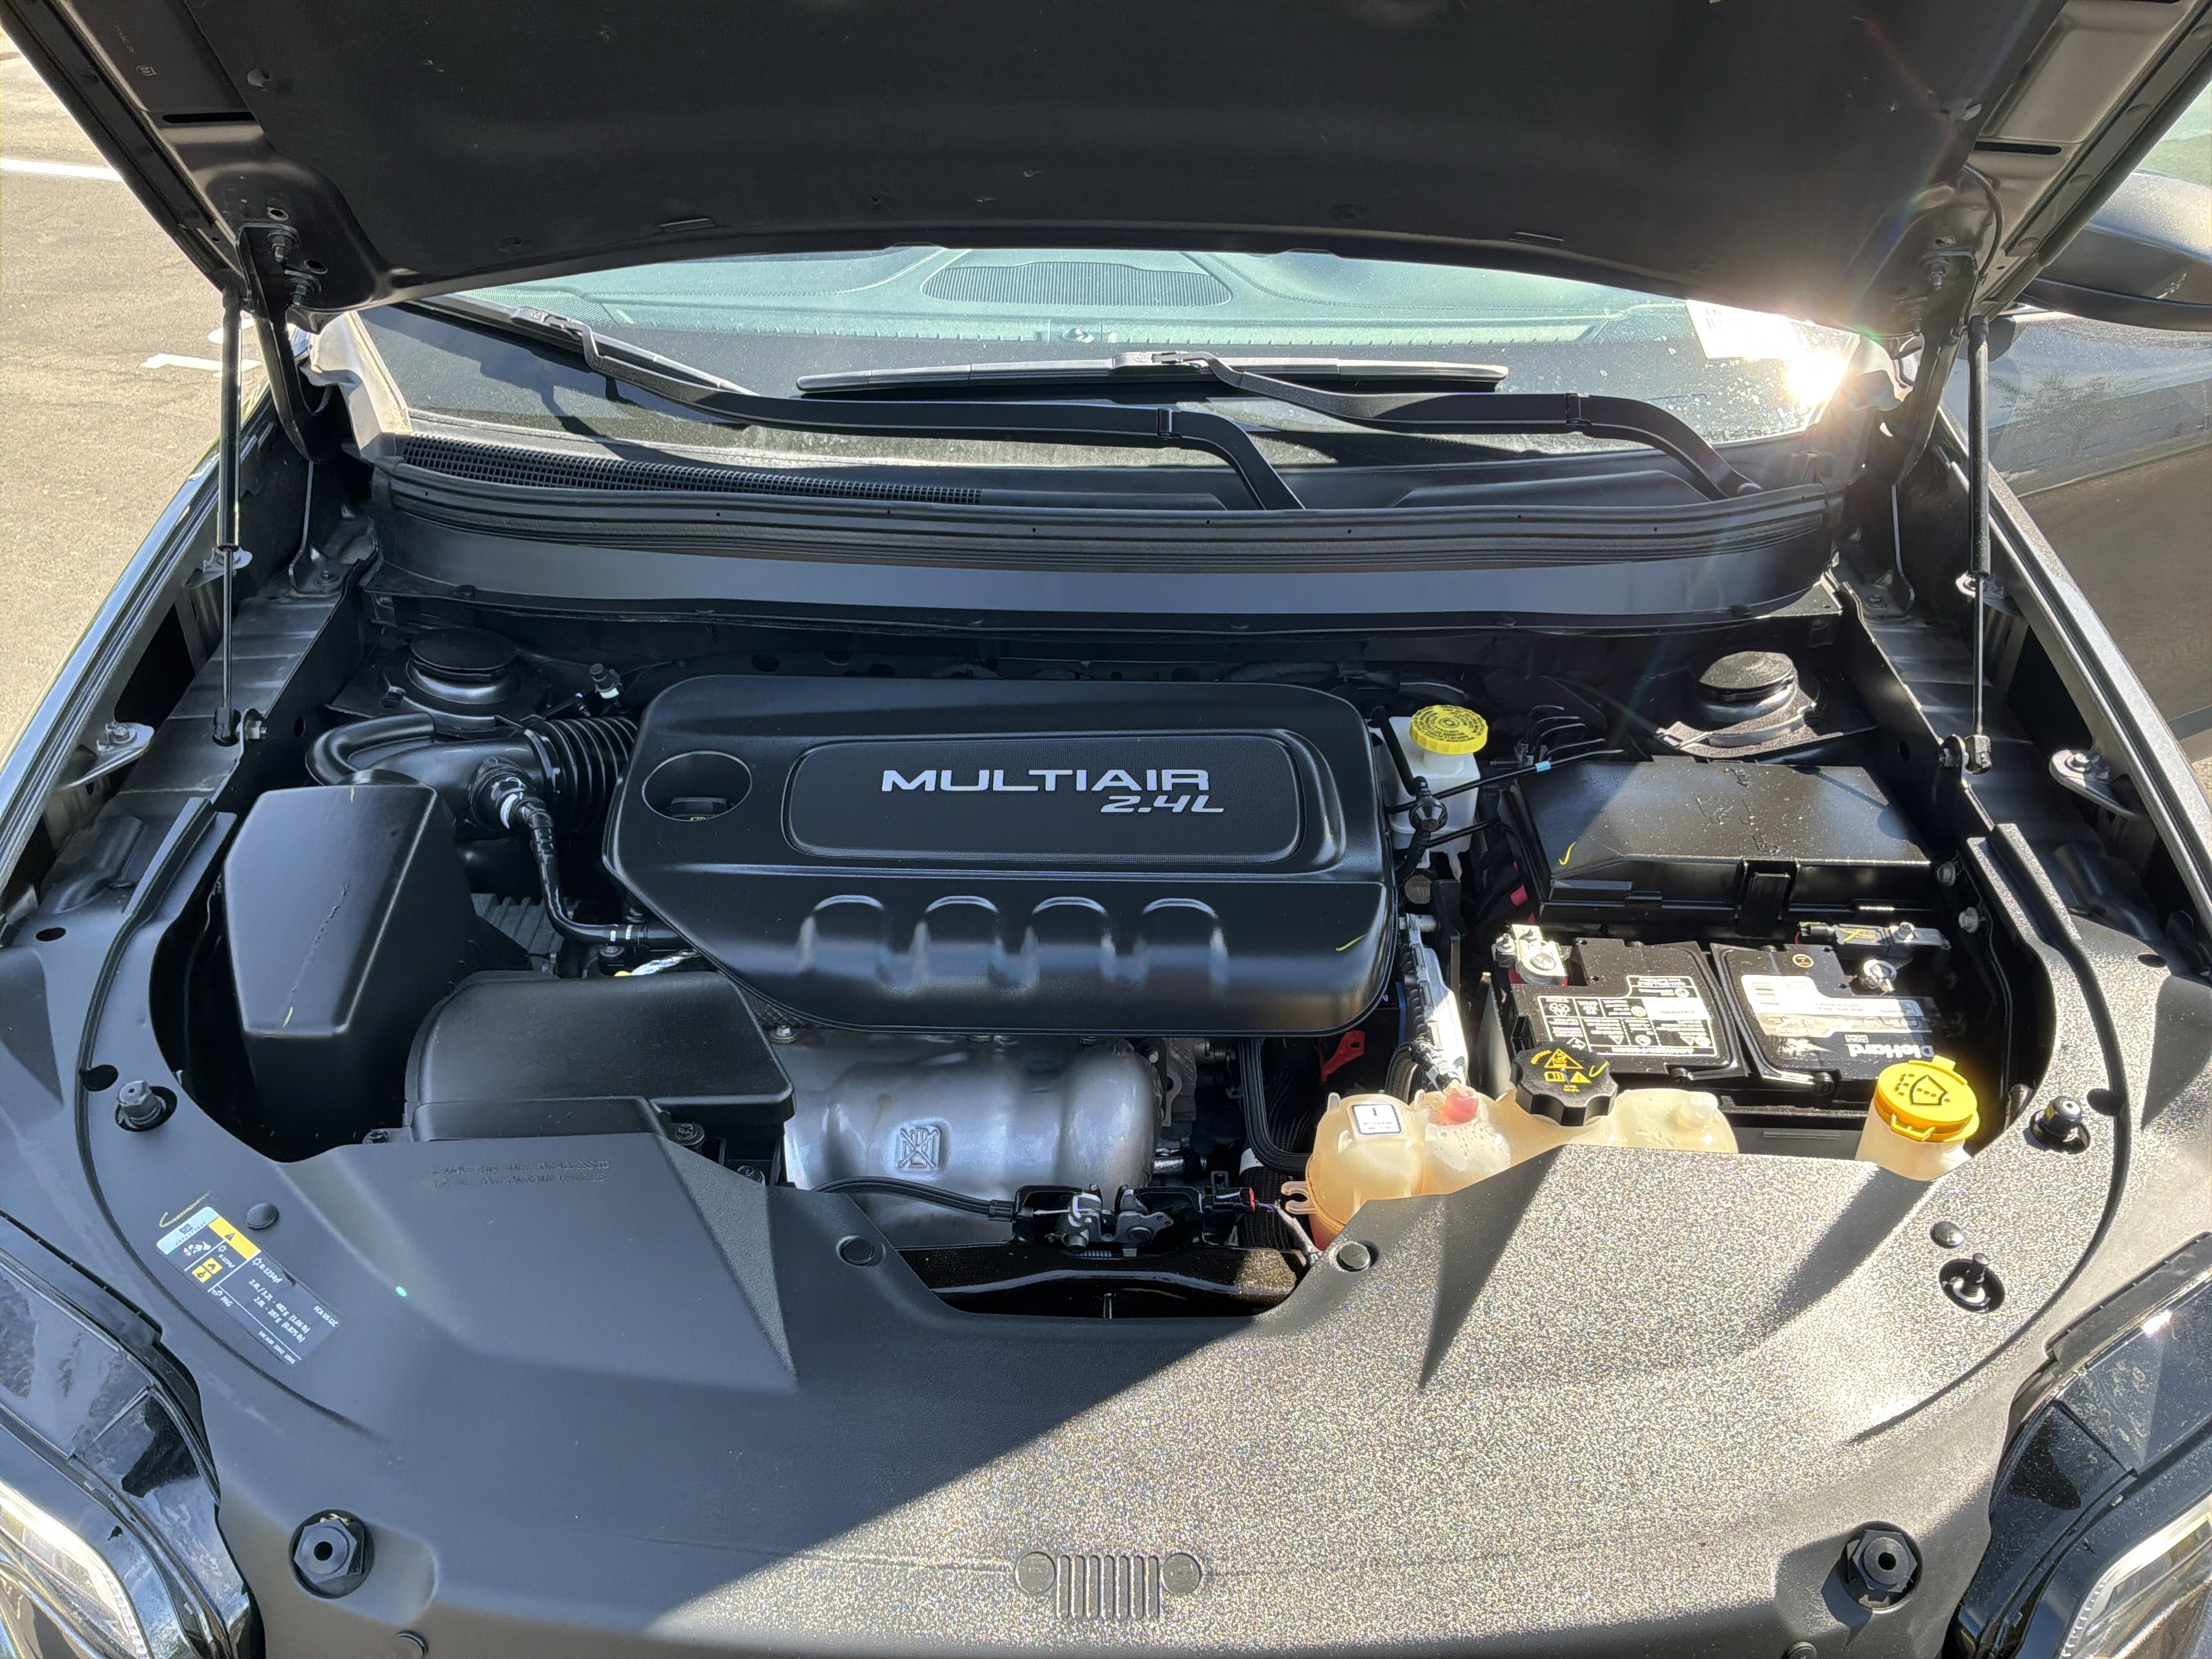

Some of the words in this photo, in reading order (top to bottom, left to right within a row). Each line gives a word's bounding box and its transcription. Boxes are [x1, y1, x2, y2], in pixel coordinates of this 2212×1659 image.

[881, 769, 1210, 792] MULTIAIR
[1100, 795, 1225, 814] 2.4L
[1848, 1044, 1934, 1058] DieHard
[221, 1296, 233, 1307] PAG
[313, 1306, 324, 1316] FCA
[322, 1312, 331, 1321] US
[328, 1318, 338, 1327] LLC
